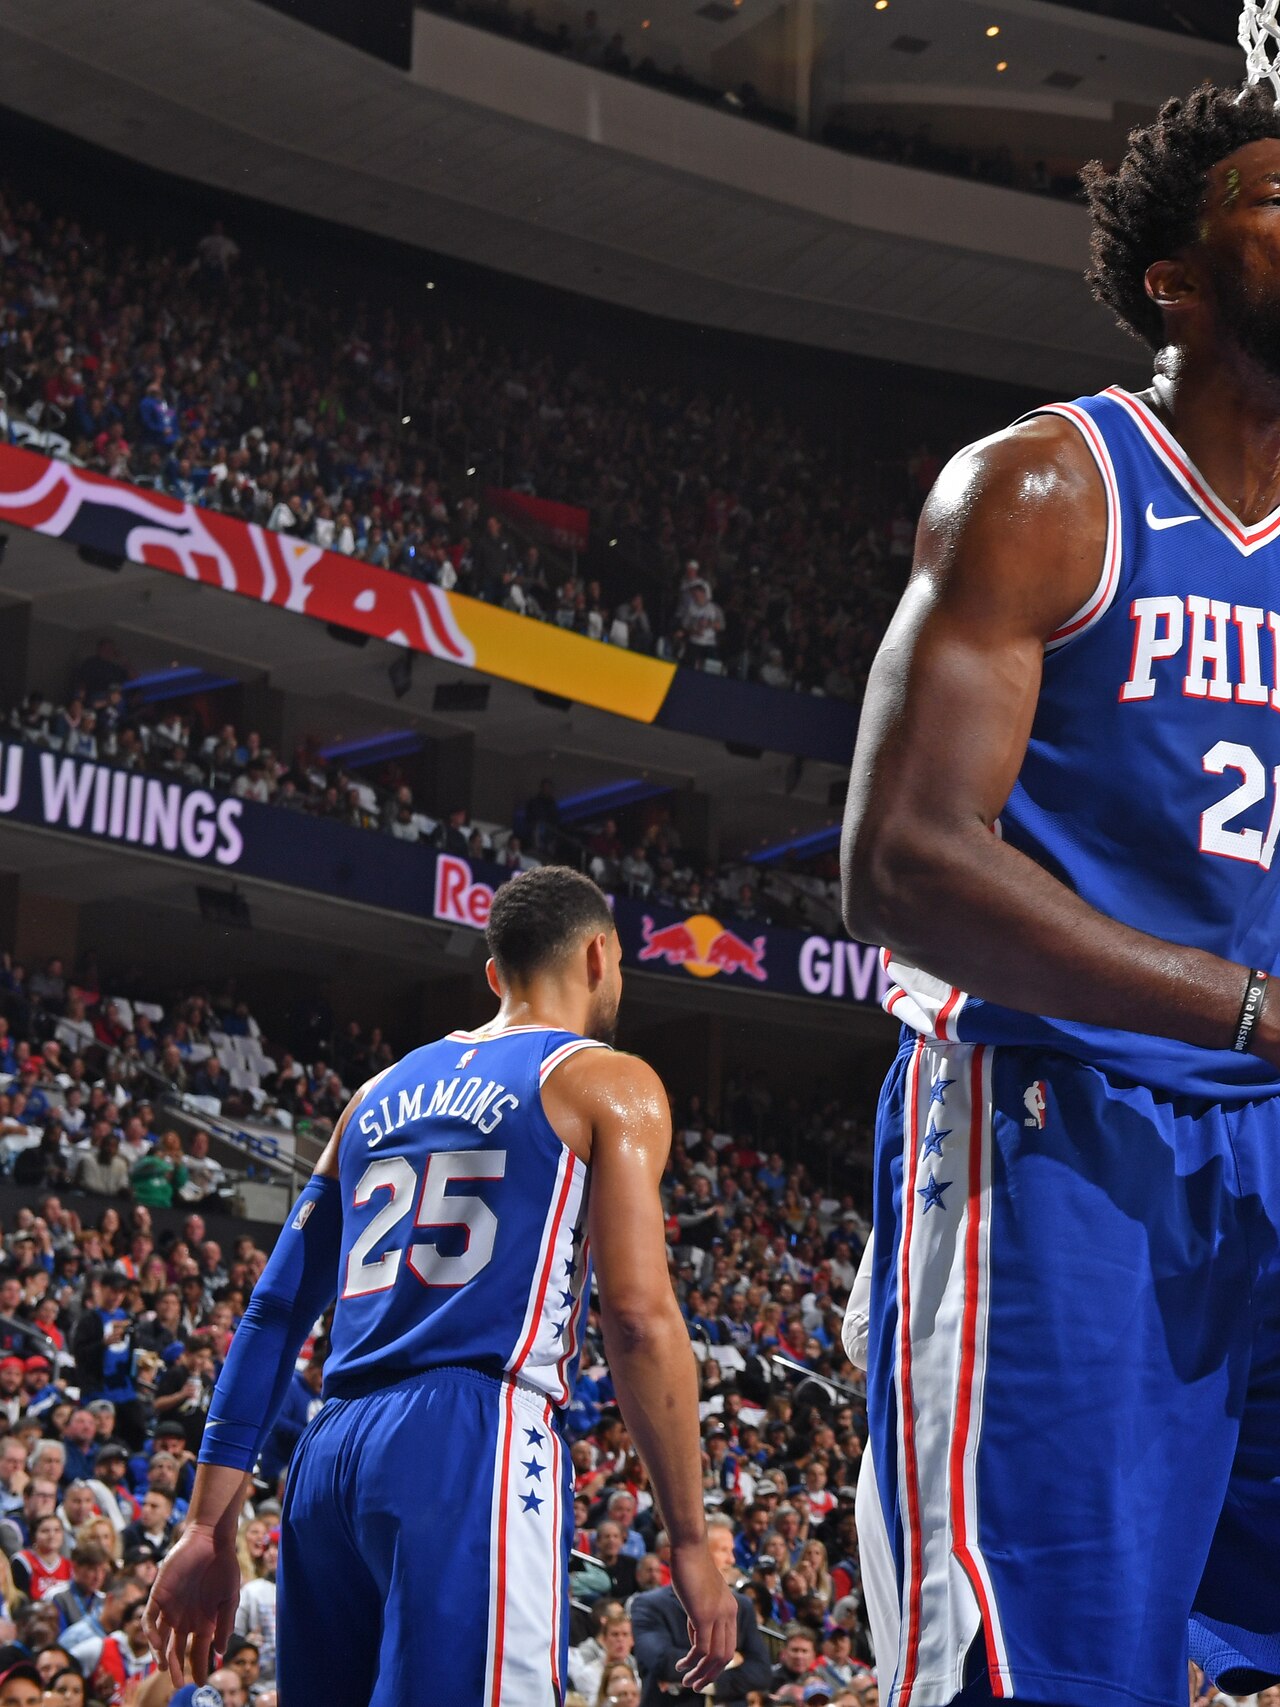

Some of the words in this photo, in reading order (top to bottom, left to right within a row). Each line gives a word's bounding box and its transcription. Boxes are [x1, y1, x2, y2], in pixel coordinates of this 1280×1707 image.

[40, 751, 244, 865] WIIINGS
[434, 853, 495, 929] Re
[798, 935, 890, 1004] GIV
[1248, 987, 1262, 1003] On
[1245, 1003, 1255, 1012] a
[358, 1076, 519, 1148] SIMMONS
[341, 1150, 507, 1299] 25
